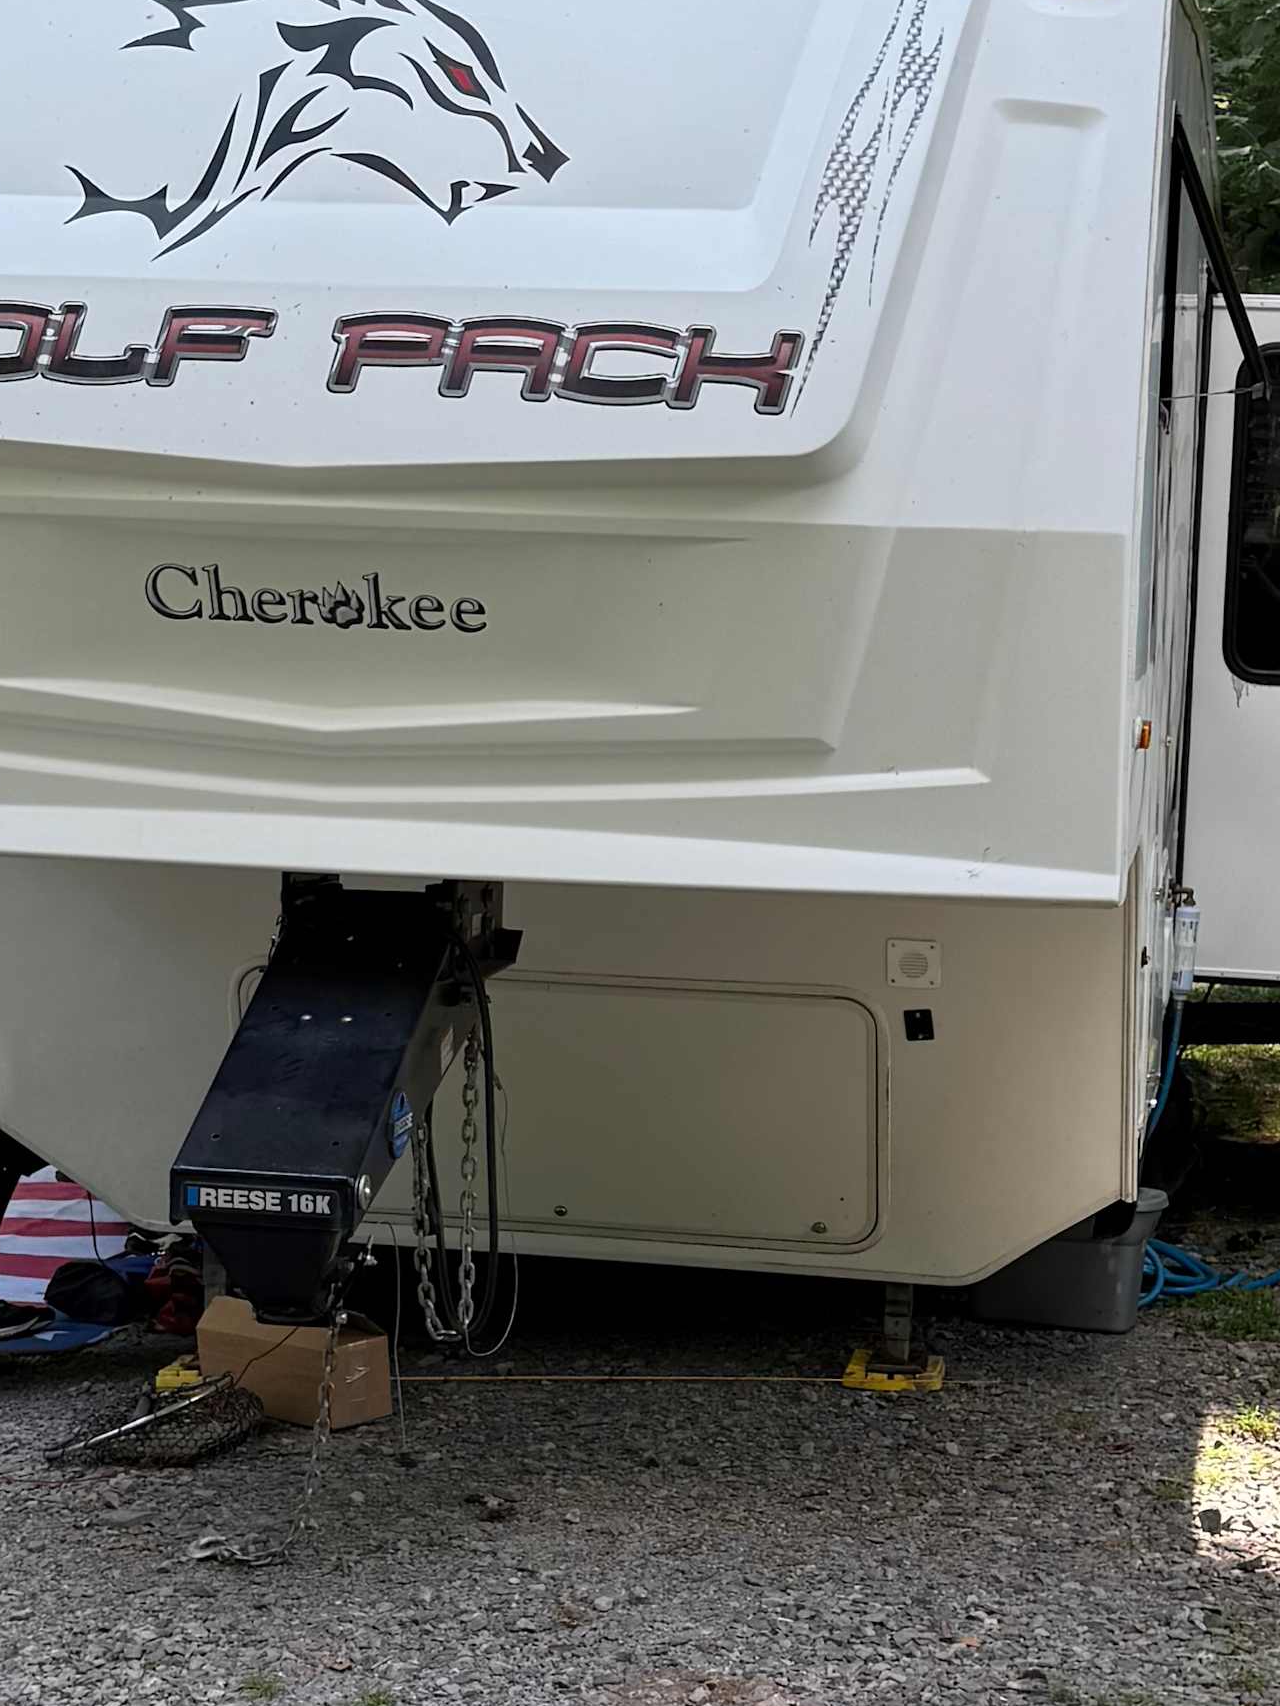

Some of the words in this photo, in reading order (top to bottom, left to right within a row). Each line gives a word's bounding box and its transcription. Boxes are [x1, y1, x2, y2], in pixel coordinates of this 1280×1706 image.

[326, 310, 804, 415] PACK
[145, 562, 488, 633] Cherokee
[199, 1187, 282, 1212] REESE
[287, 1193, 331, 1215] 16K
